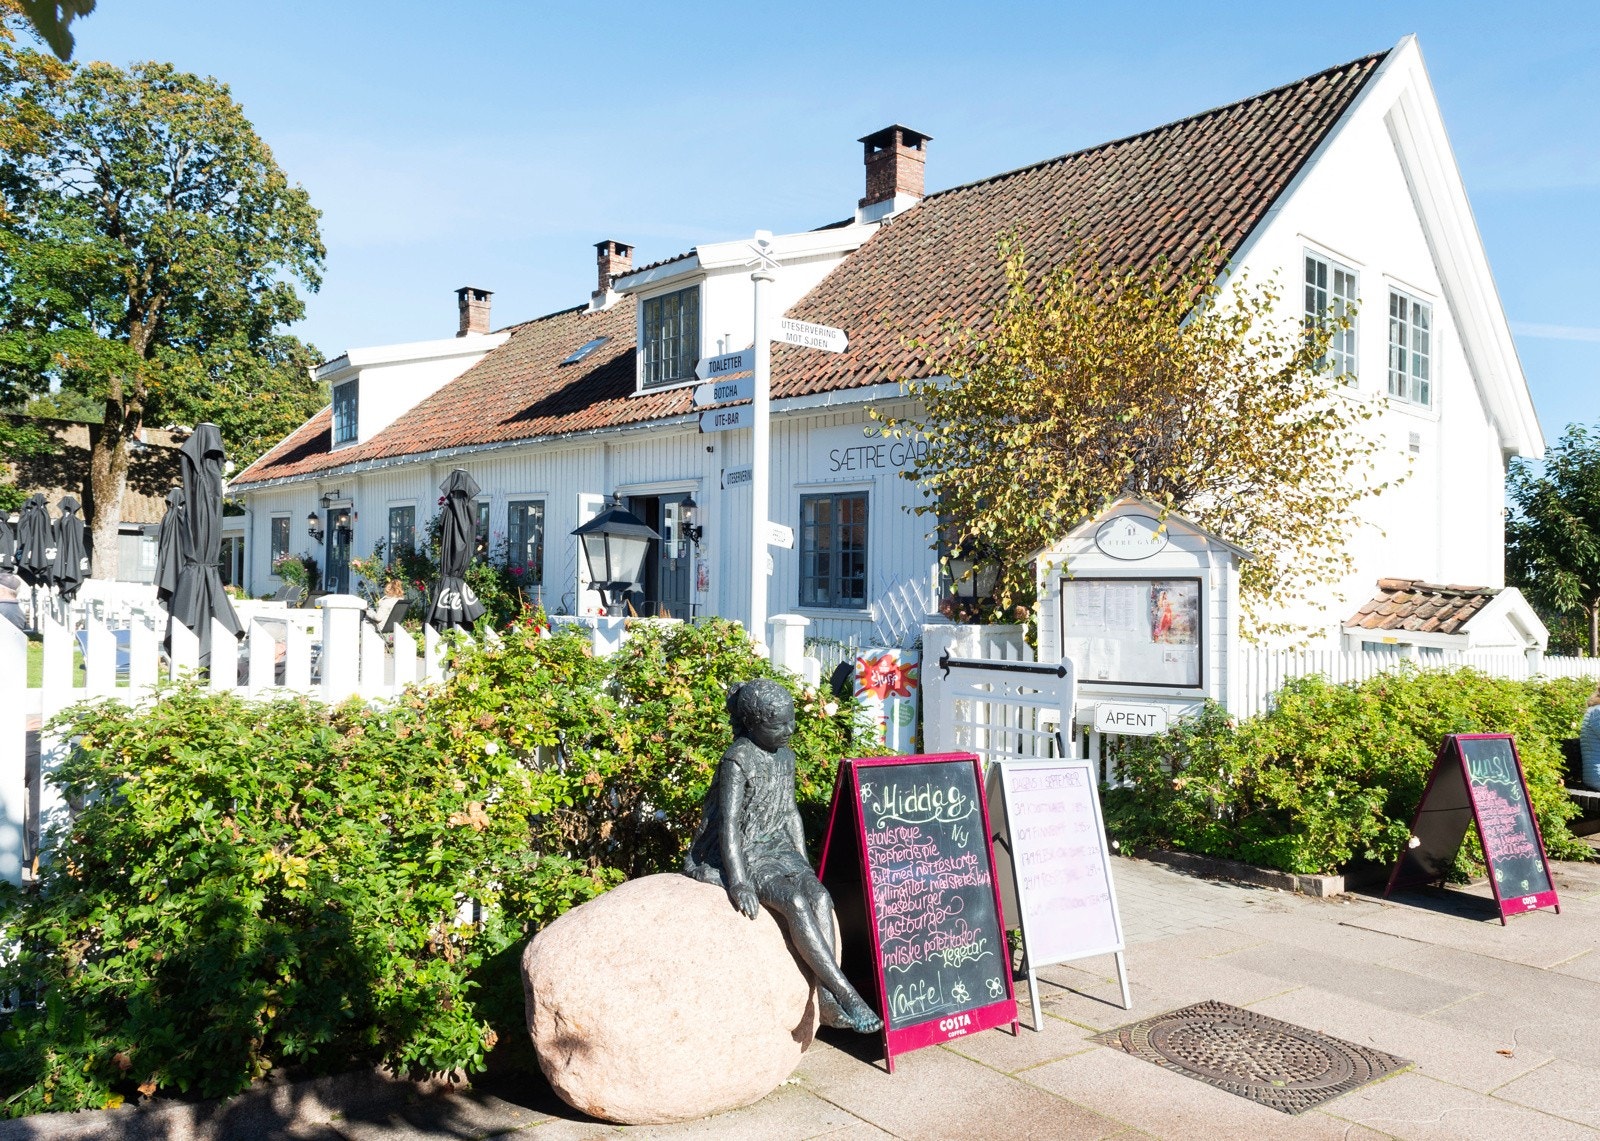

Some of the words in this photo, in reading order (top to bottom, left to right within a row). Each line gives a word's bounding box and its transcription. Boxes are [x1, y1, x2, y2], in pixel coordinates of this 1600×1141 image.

[781, 320, 837, 339] UTESERVERING
[786, 332, 802, 343] MOT
[709, 355, 742, 373] TOALETTER
[713, 384, 738, 400] BOTCHA
[714, 412, 739, 427] UTE-BAR
[829, 444, 886, 472] SÆTRE
[726, 469, 753, 485] UTESERVERIN
[873, 783, 967, 817] Middag
[922, 843, 940, 862] pie
[892, 862, 914, 882] med
[940, 1014, 971, 1032] COSTA
